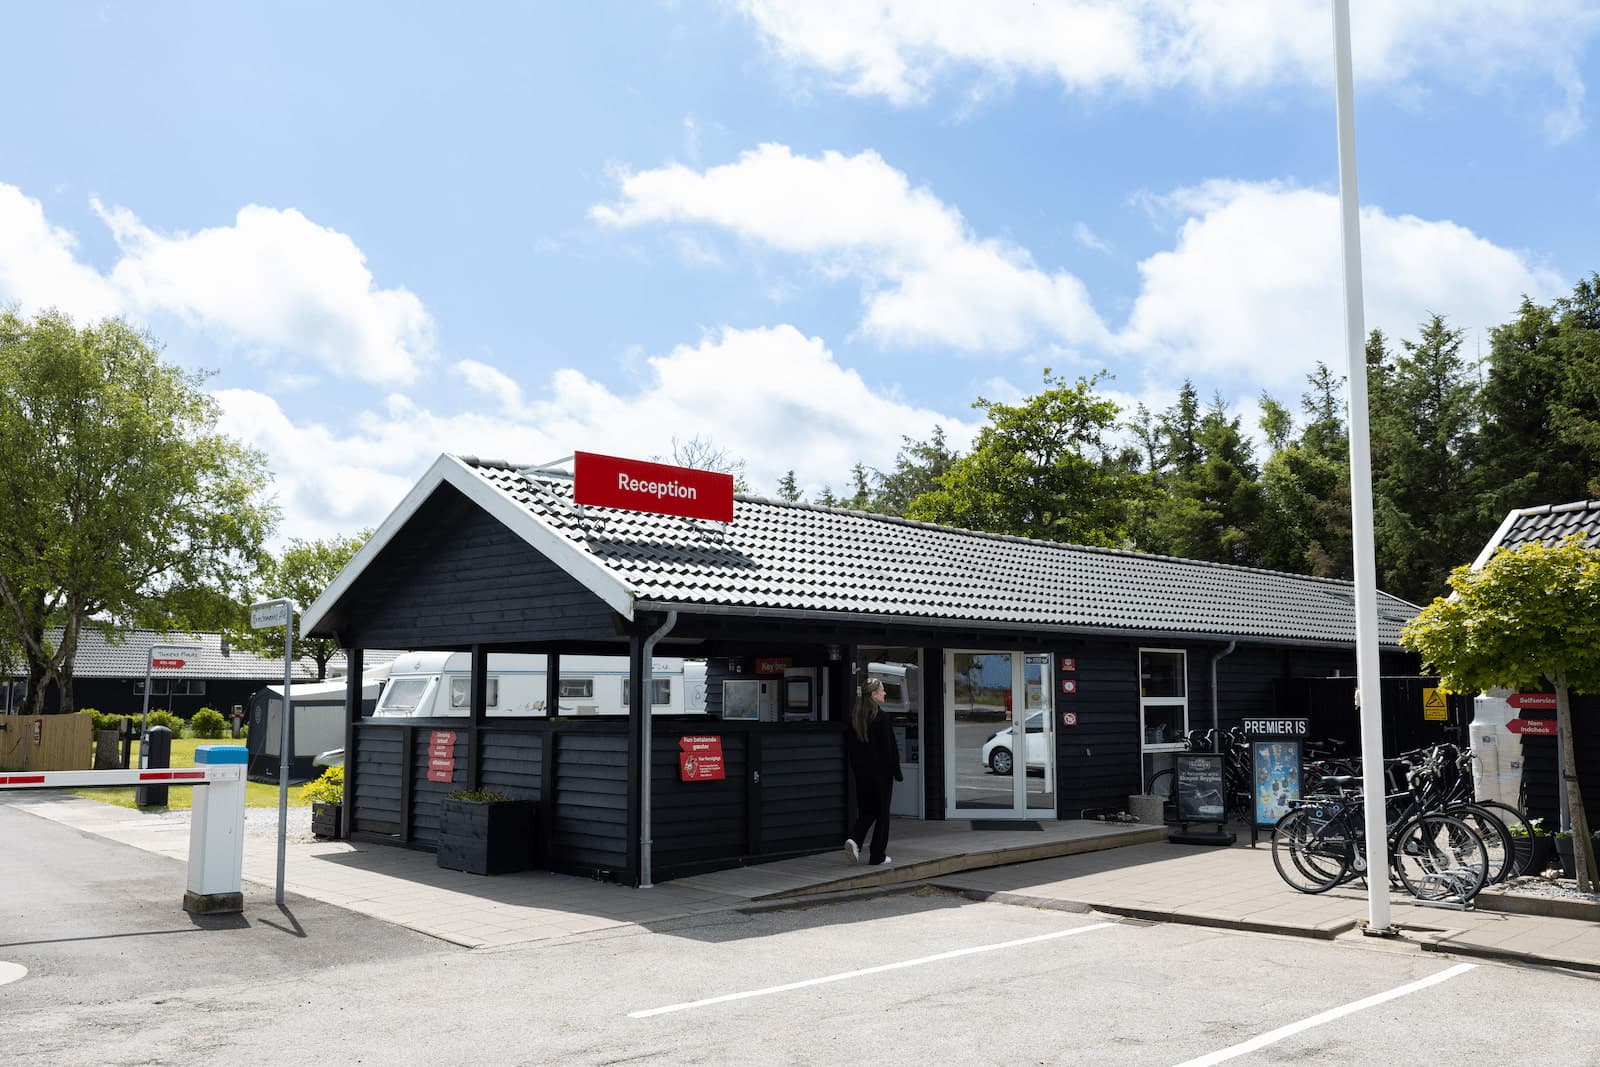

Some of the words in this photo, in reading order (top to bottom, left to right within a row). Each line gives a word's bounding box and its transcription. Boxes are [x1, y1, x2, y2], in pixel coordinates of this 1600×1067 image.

[618, 472, 697, 500] Reception
[1244, 720, 1293, 734] PREMIER
[1295, 720, 1306, 734] IS
